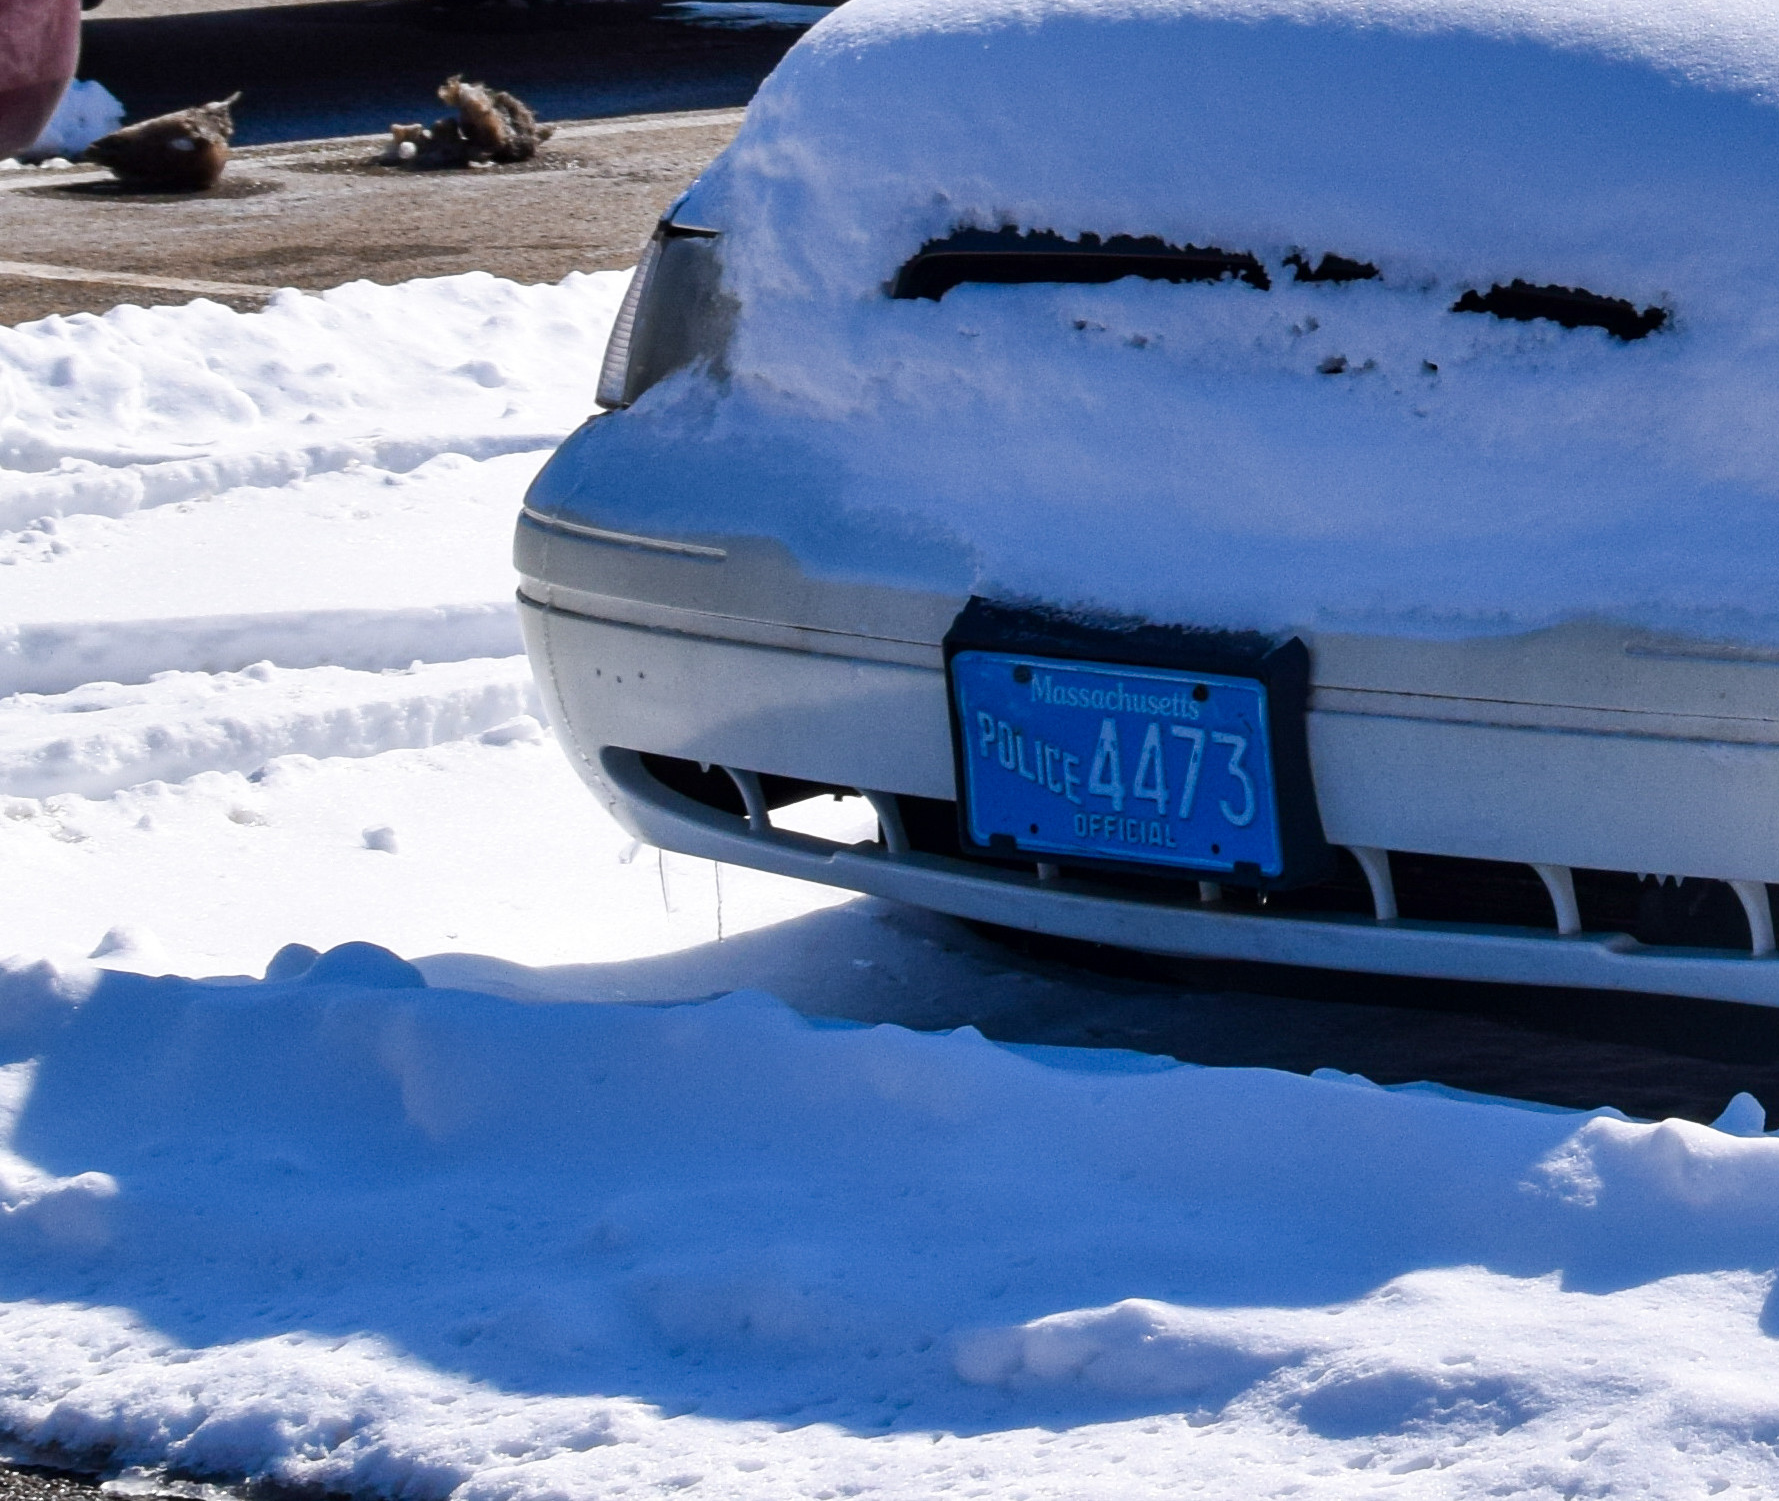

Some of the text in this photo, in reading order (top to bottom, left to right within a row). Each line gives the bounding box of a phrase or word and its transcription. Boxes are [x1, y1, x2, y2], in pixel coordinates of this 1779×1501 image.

[1030, 673, 1200, 721] Massachusetts
[976, 710, 1255, 827] POLICE 4473
[1074, 812, 1177, 850] OFFICIAL
